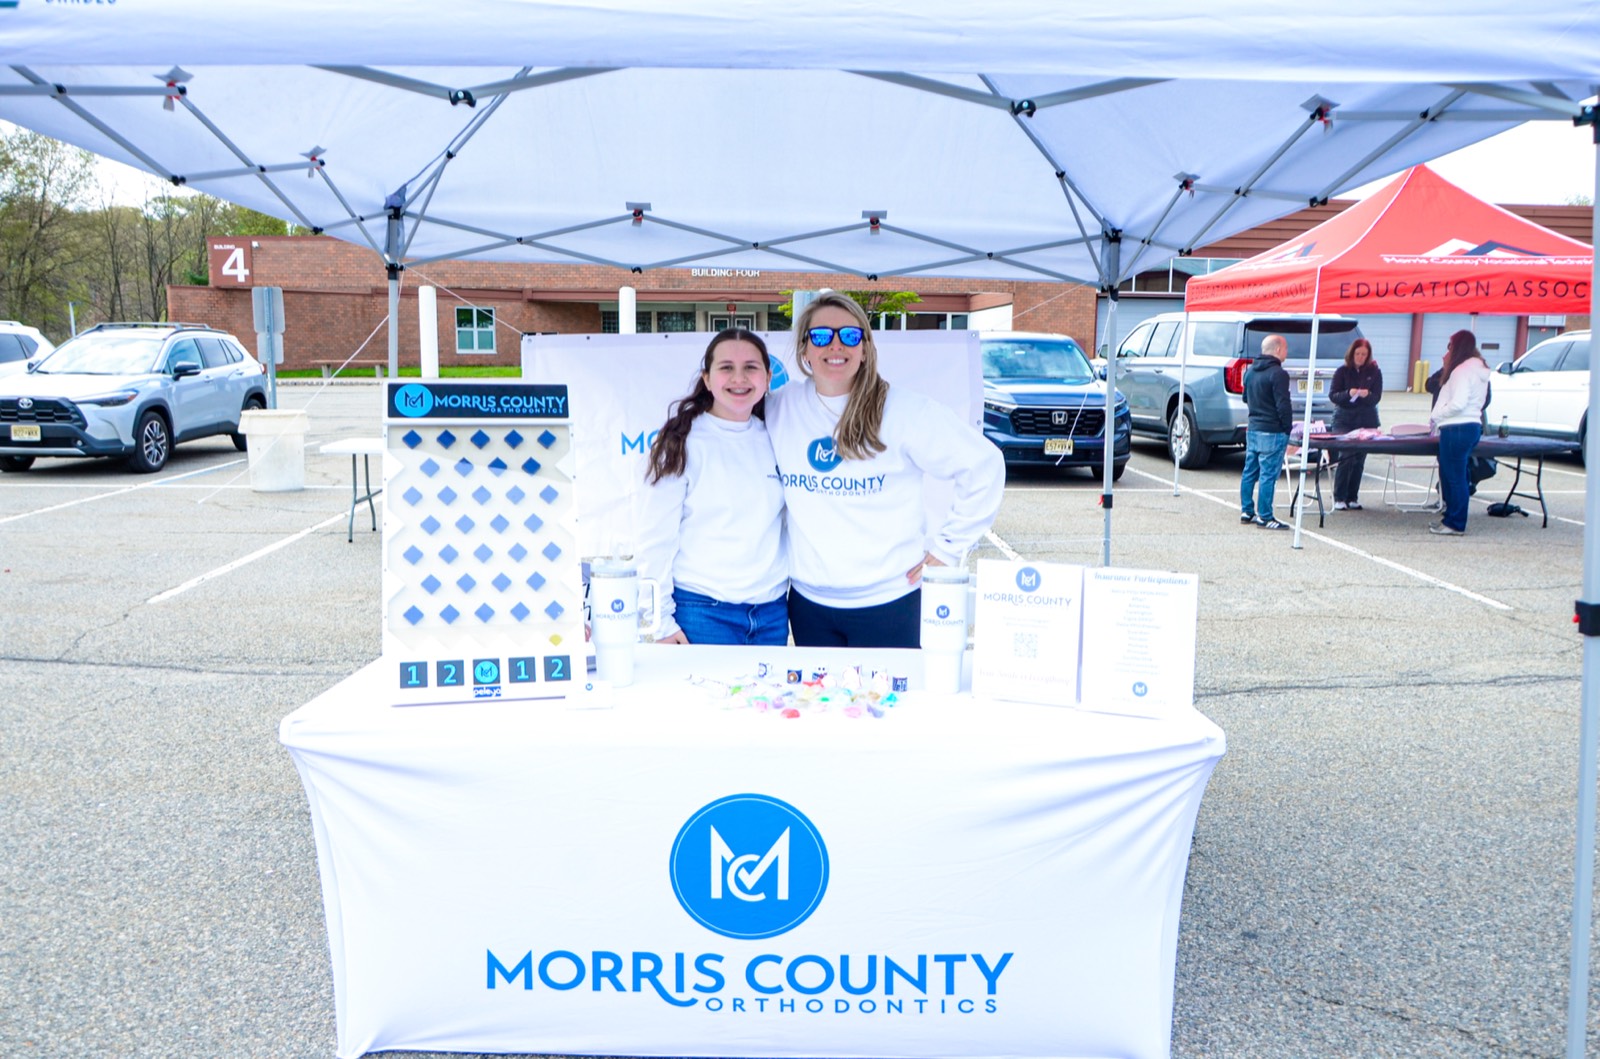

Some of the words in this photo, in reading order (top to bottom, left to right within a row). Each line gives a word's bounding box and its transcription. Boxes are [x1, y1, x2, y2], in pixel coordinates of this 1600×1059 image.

[222, 248, 249, 282] 4
[691, 268, 733, 277] BUILDING
[736, 269, 760, 278] FOUR
[1340, 280, 1490, 299] EDUCATION
[1504, 280, 1588, 299] ASSOC
[434, 394, 497, 412] MORRIS
[500, 396, 566, 409] COUNTY
[821, 474, 886, 491] COUNTY
[984, 592, 1024, 606] MORRIS
[1026, 595, 1072, 607] COUNTY
[407, 665, 420, 685] 1
[443, 664, 457, 684] 2
[516, 660, 530, 680] 1
[551, 658, 564, 678] 2
[486, 948, 725, 1008] MORRIS
[746, 952, 1014, 996] COUNTY
[705, 997, 998, 1014] ORTHODONTICS
